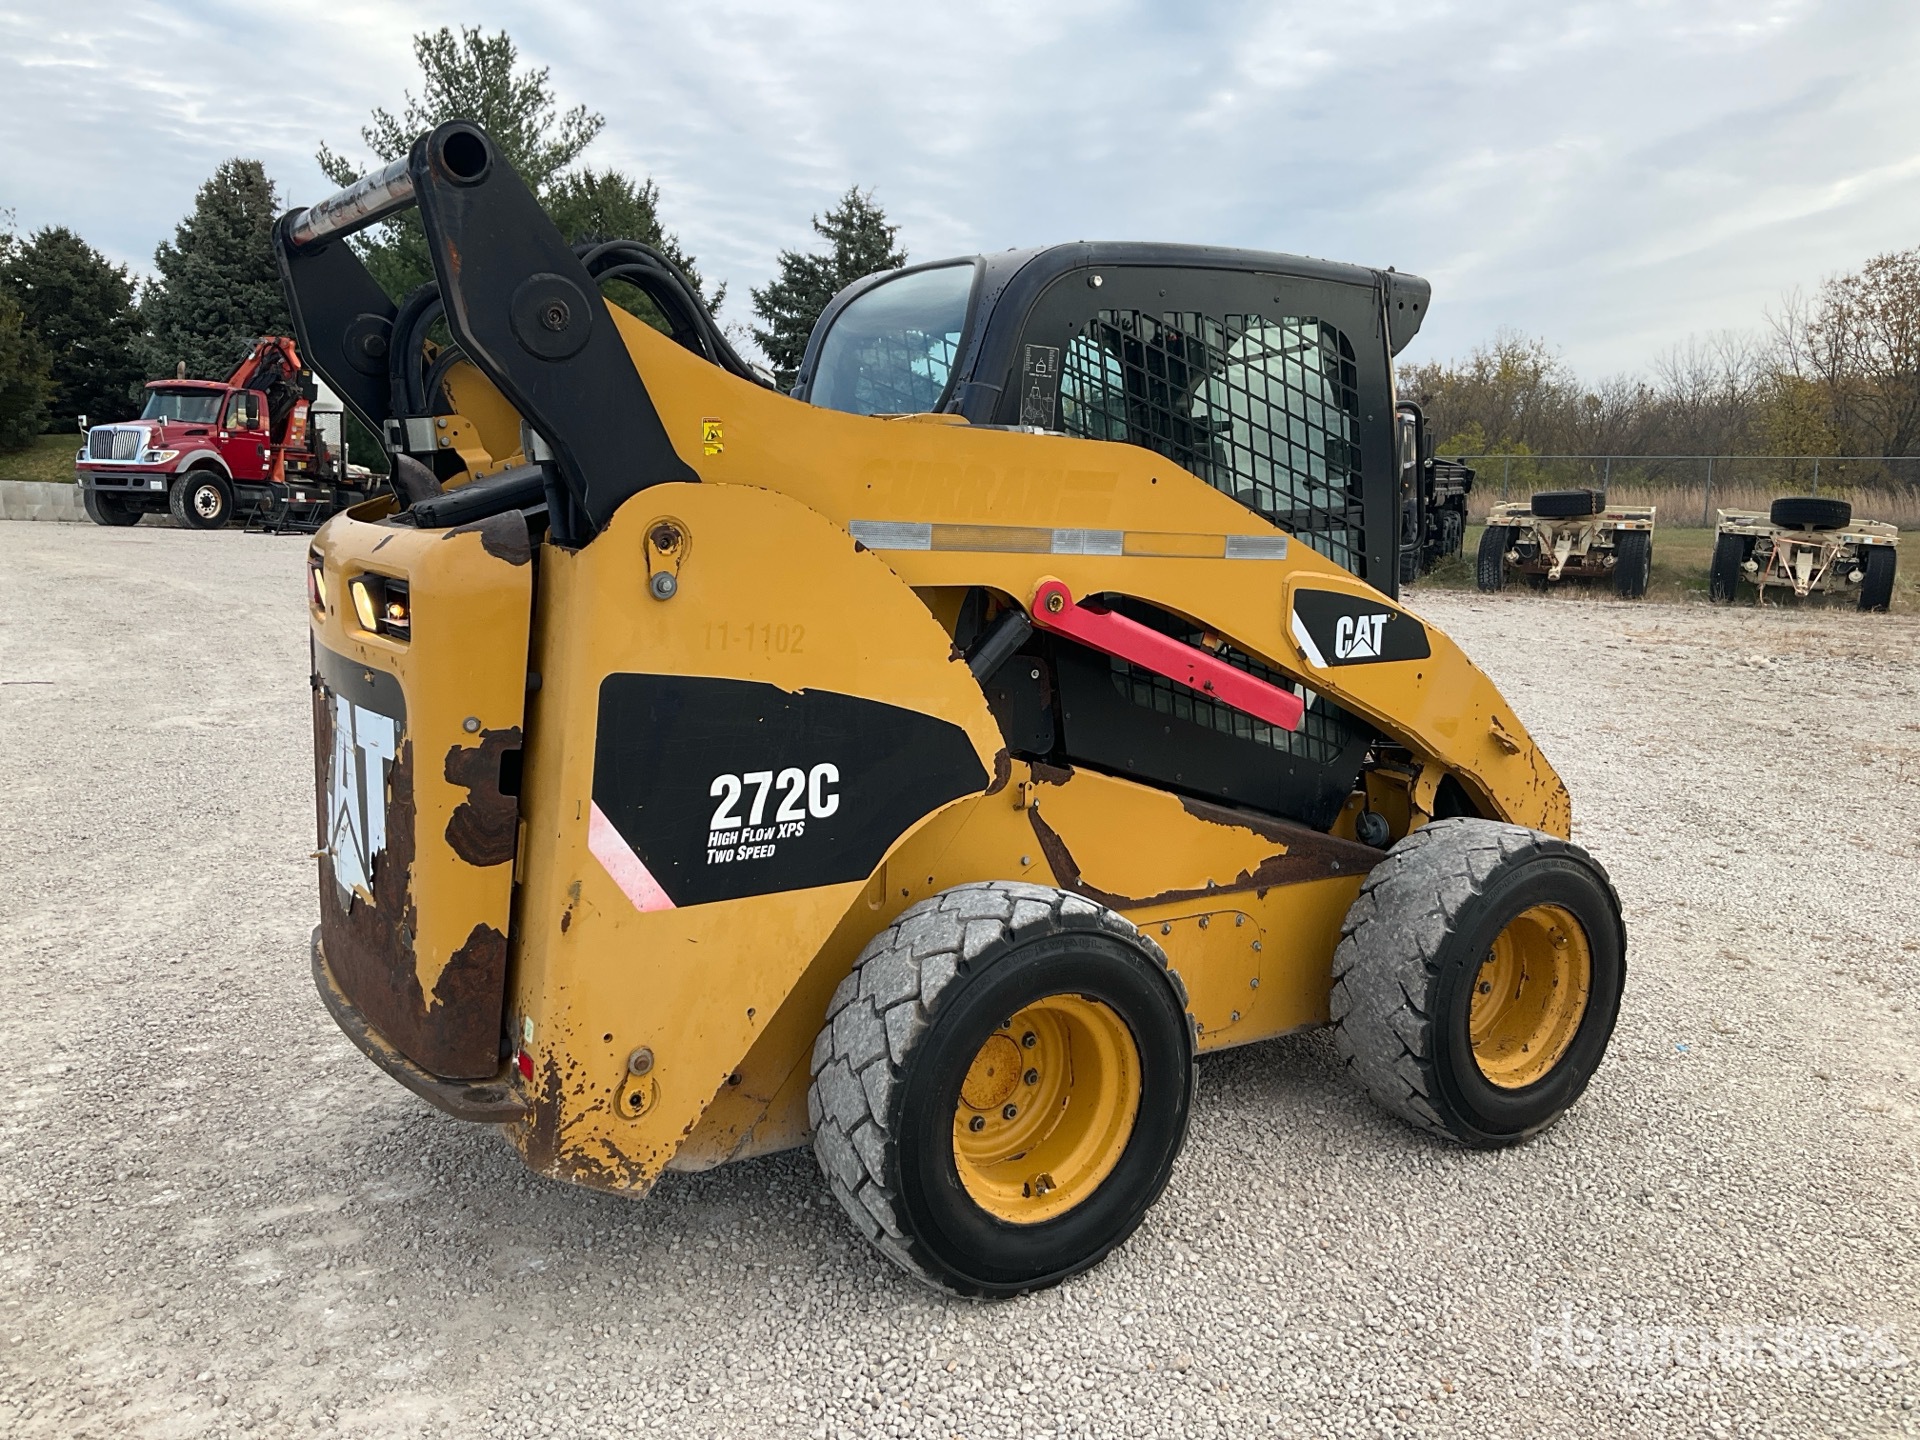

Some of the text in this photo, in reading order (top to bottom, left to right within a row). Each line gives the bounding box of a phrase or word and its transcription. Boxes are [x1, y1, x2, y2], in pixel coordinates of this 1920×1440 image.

[701, 620, 806, 654] 11-1102
[1335, 614, 1388, 659] CAT
[328, 693, 395, 893] AT
[710, 762, 840, 830] 272C
[707, 821, 805, 847] HIGH FLOW XPS
[706, 844, 775, 864] TWO SPEED
